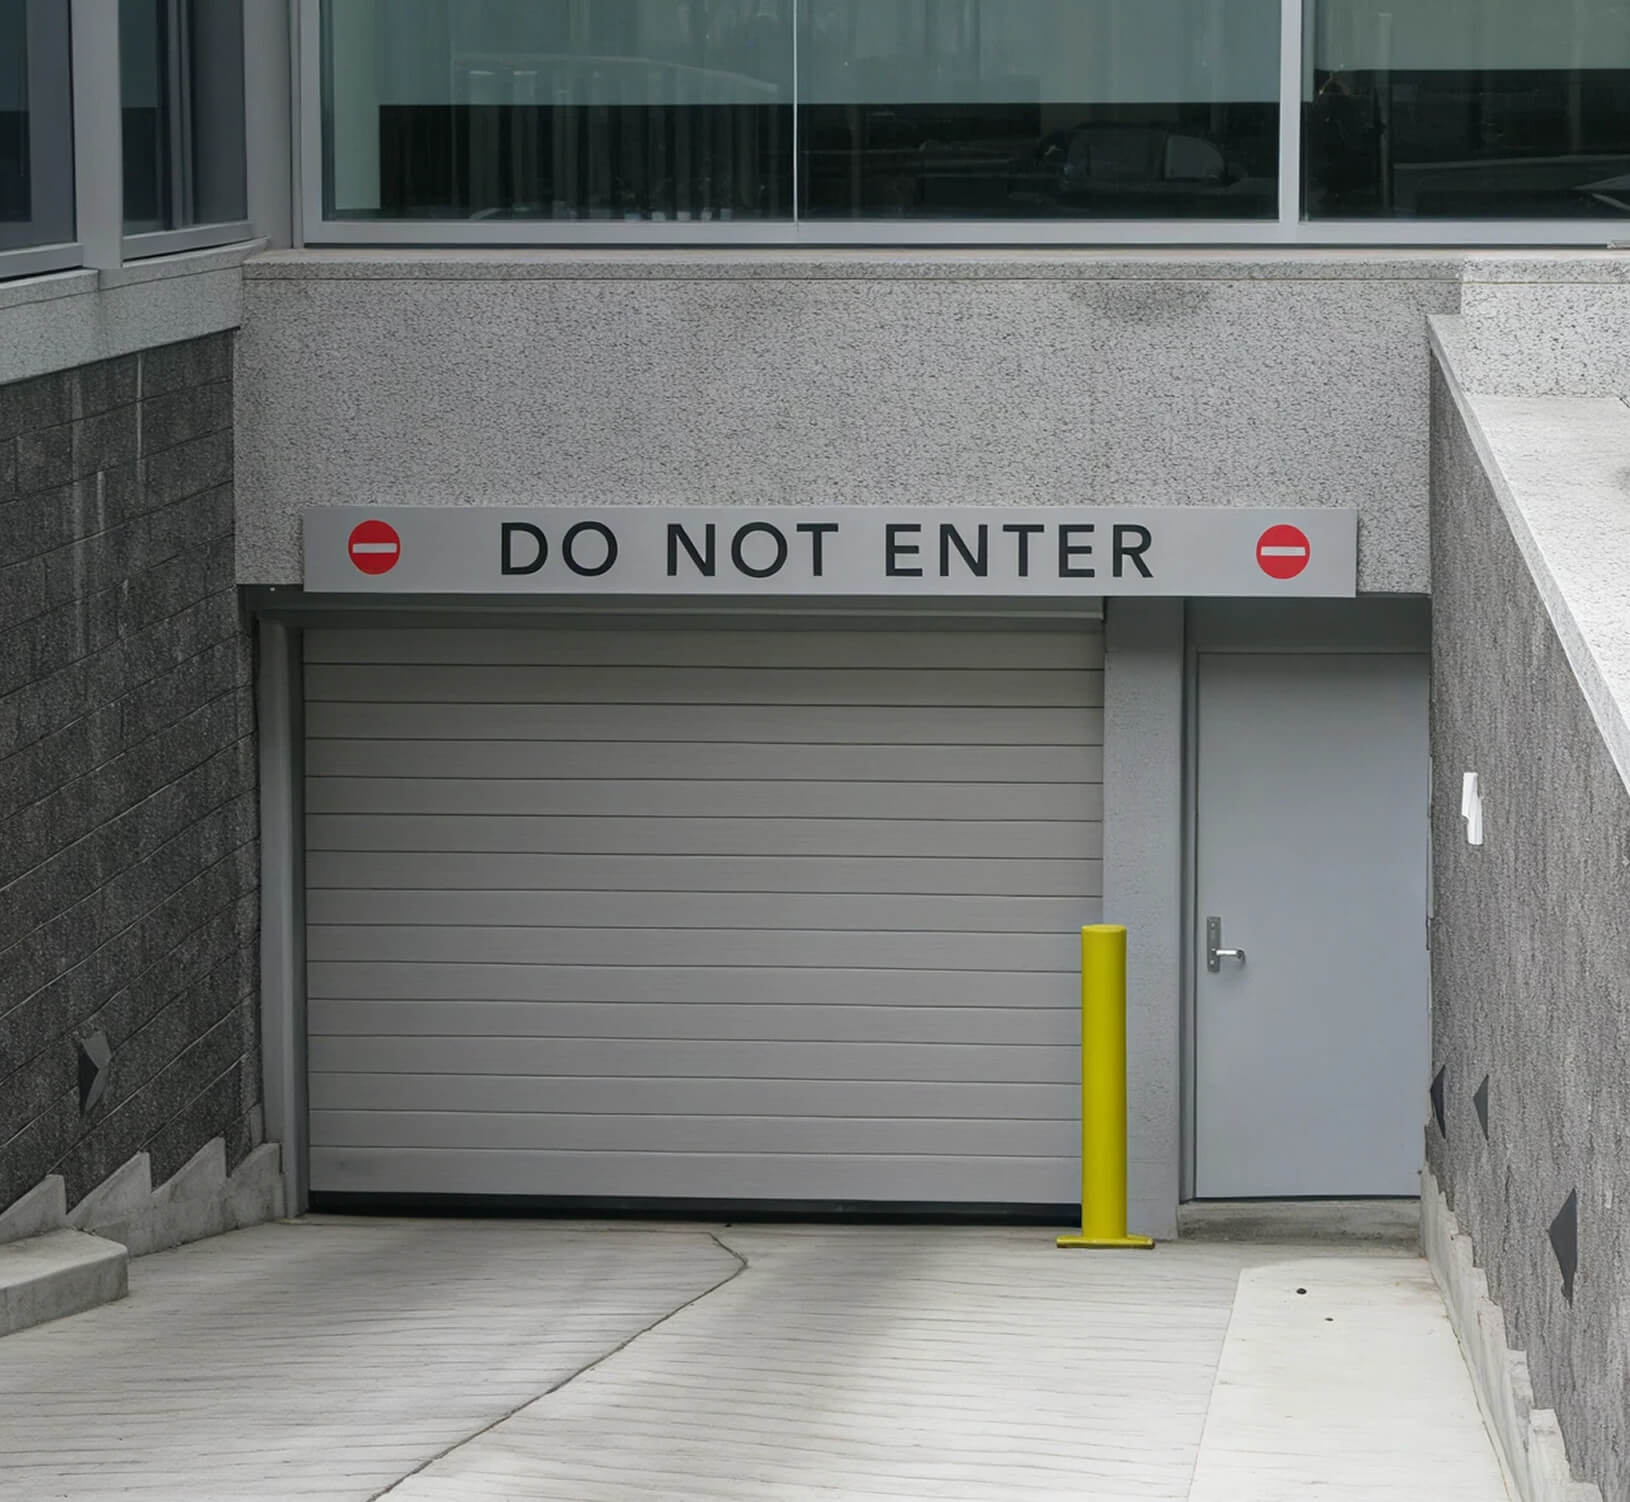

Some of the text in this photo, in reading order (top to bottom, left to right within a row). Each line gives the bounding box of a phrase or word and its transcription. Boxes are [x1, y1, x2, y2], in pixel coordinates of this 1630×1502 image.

[500, 521, 1154, 578] DO NOT ENTER
